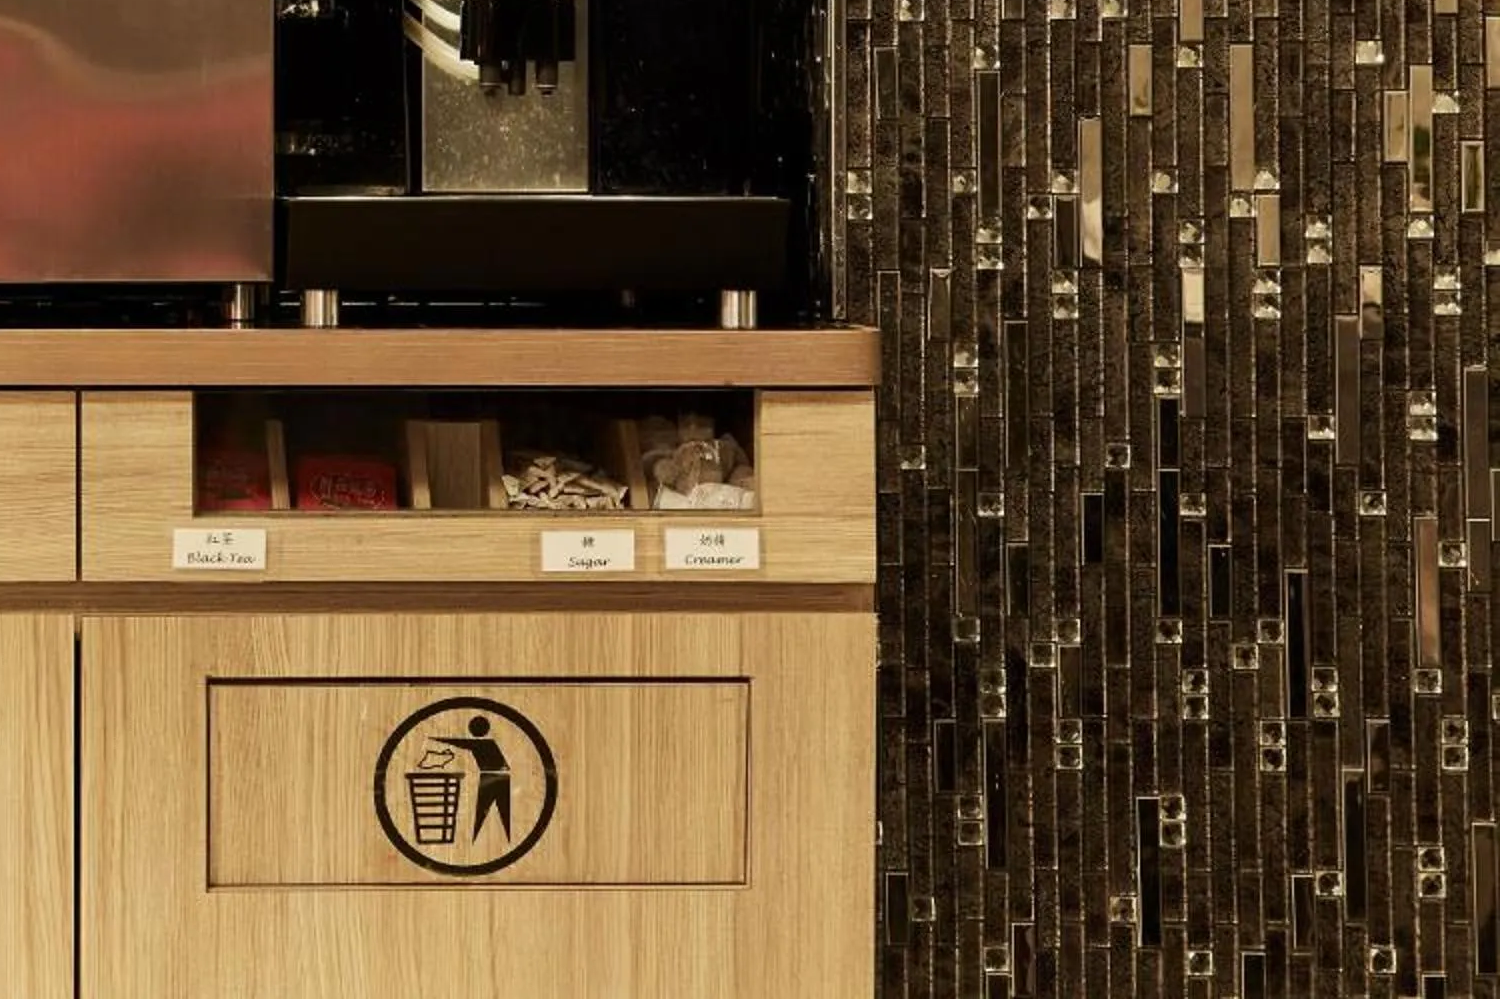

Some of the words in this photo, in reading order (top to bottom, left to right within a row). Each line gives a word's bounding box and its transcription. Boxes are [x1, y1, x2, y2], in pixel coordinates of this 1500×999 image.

[187, 551, 223, 564] Black
[229, 552, 257, 564] Tea
[567, 556, 611, 570] Sugar
[684, 554, 746, 566] Creamer
